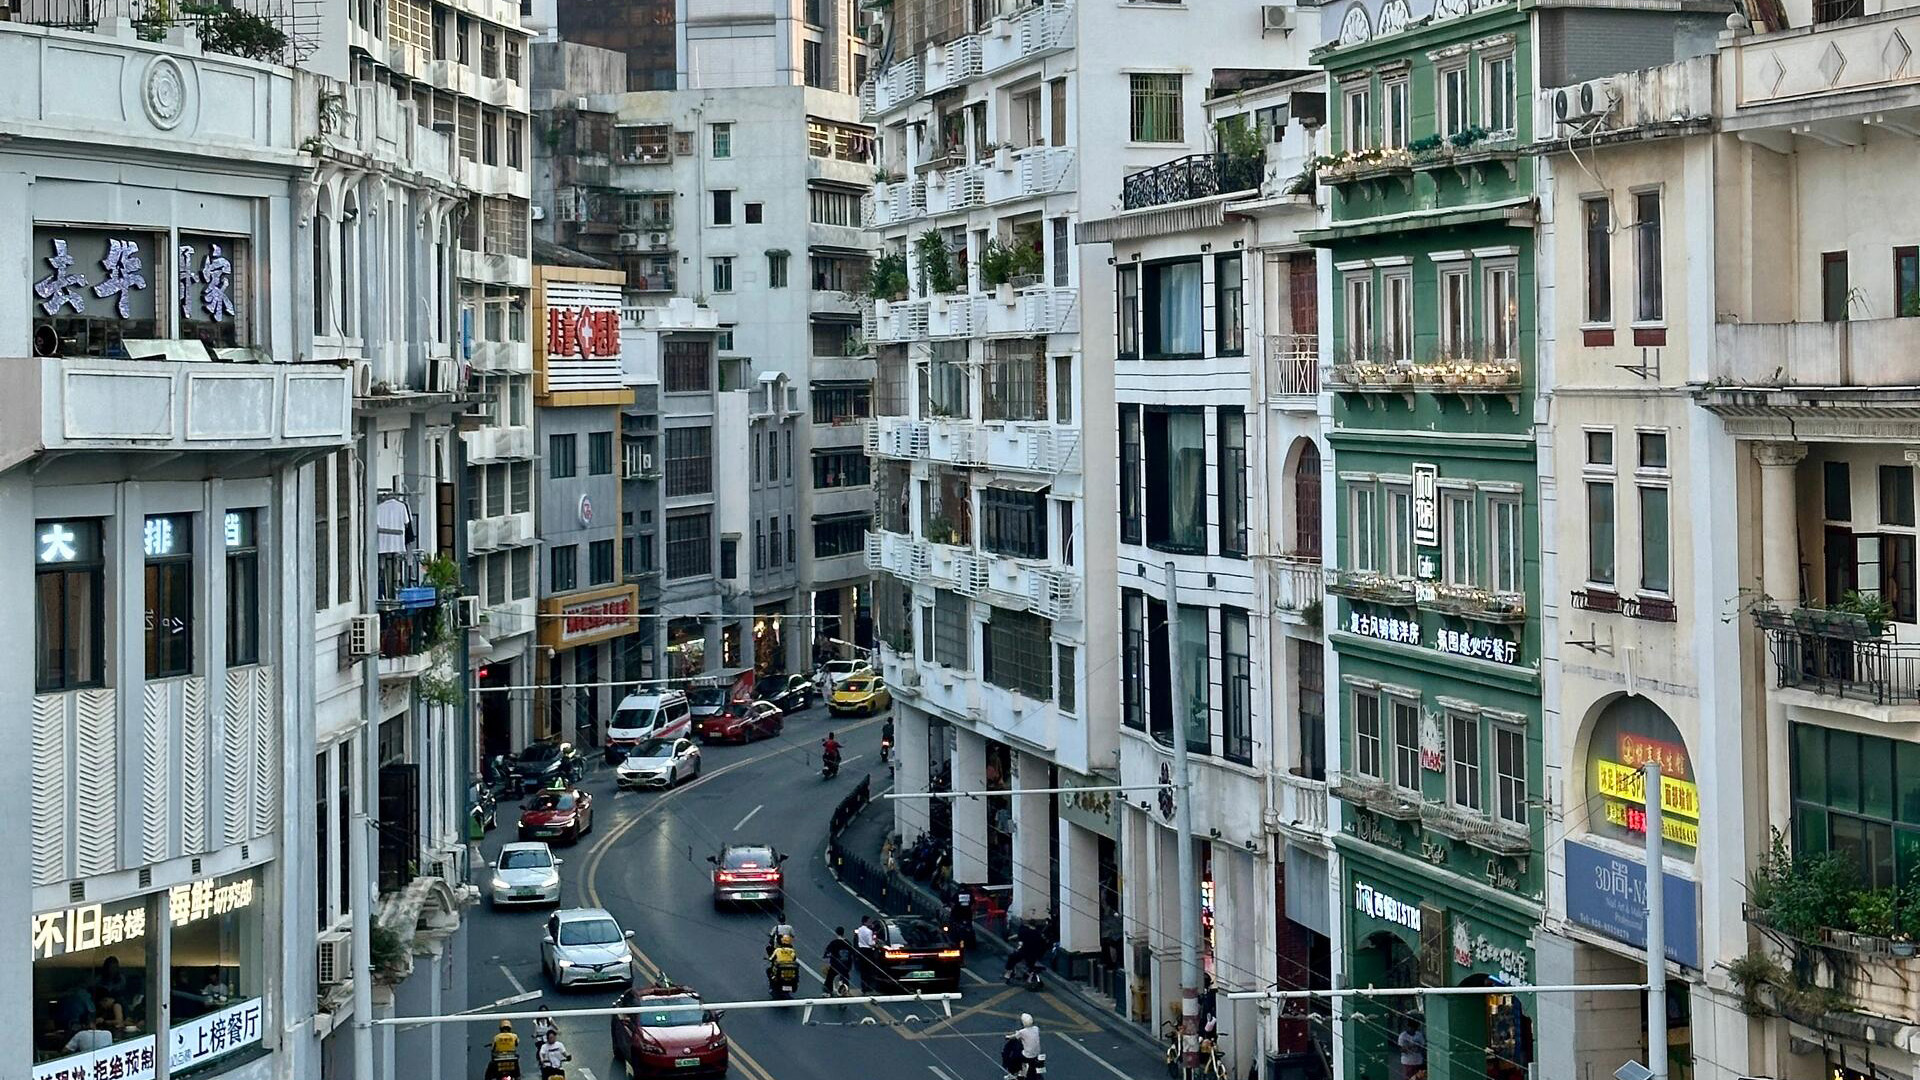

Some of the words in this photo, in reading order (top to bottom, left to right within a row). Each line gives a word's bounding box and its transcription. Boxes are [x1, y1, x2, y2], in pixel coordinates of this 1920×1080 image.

[1437, 628, 1517, 664] 氛围感必吃餐厅
[193, 1006, 260, 1059] 上榜餐厅
